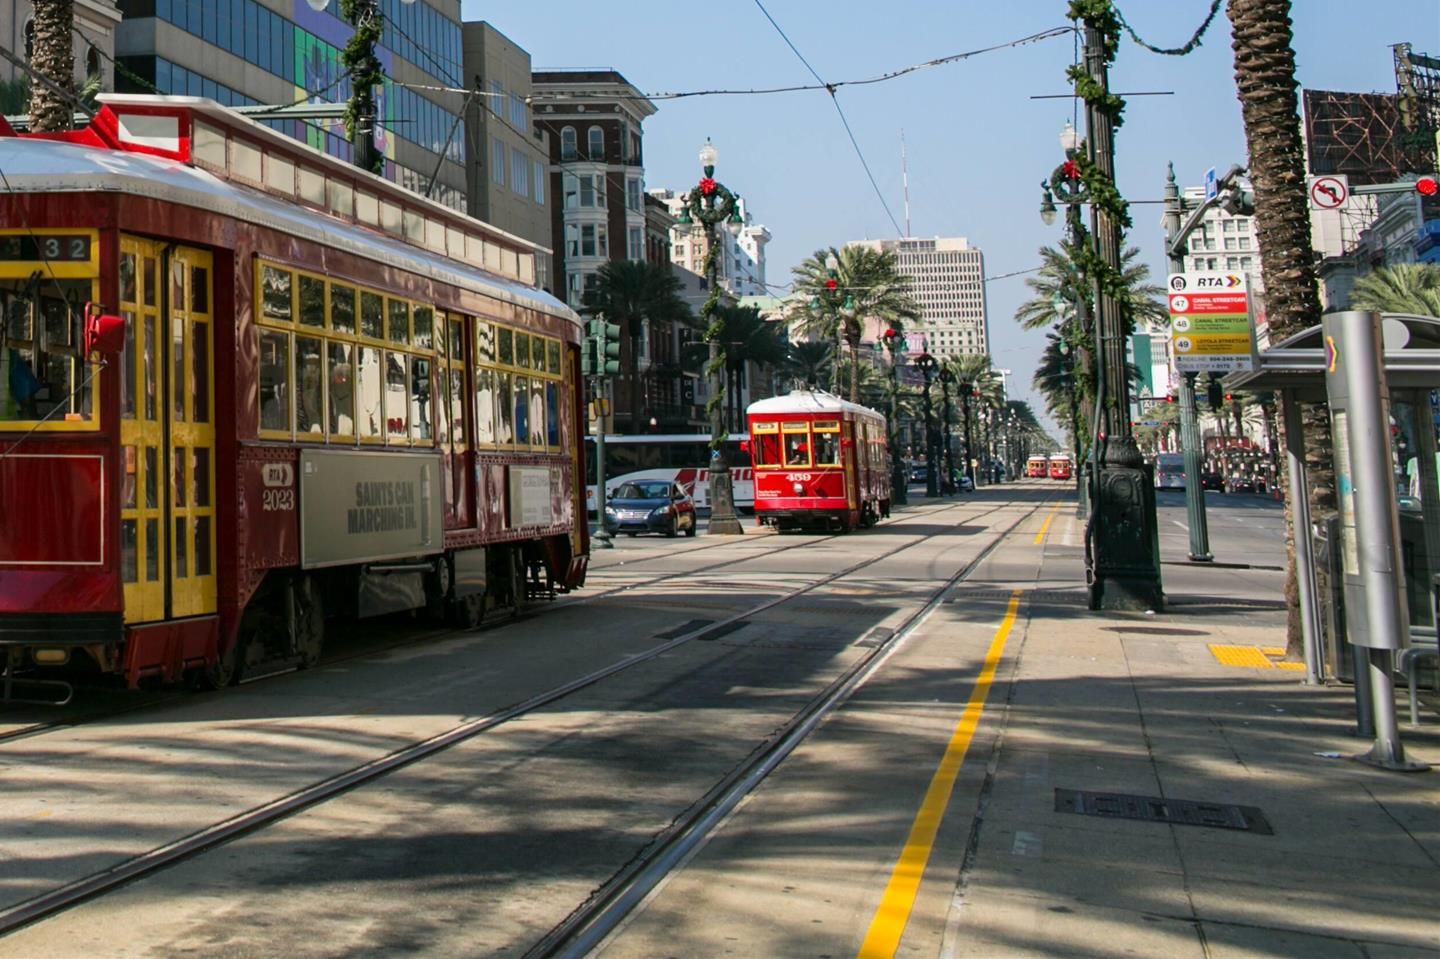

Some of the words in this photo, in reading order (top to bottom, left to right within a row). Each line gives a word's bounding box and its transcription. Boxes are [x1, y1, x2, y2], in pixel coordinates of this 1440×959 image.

[1198, 277, 1223, 287] RTA
[269, 468, 280, 482] RTA
[263, 489, 294, 511] 2023
[355, 481, 394, 507] SAINTS
[347, 506, 404, 534] MARCHING
